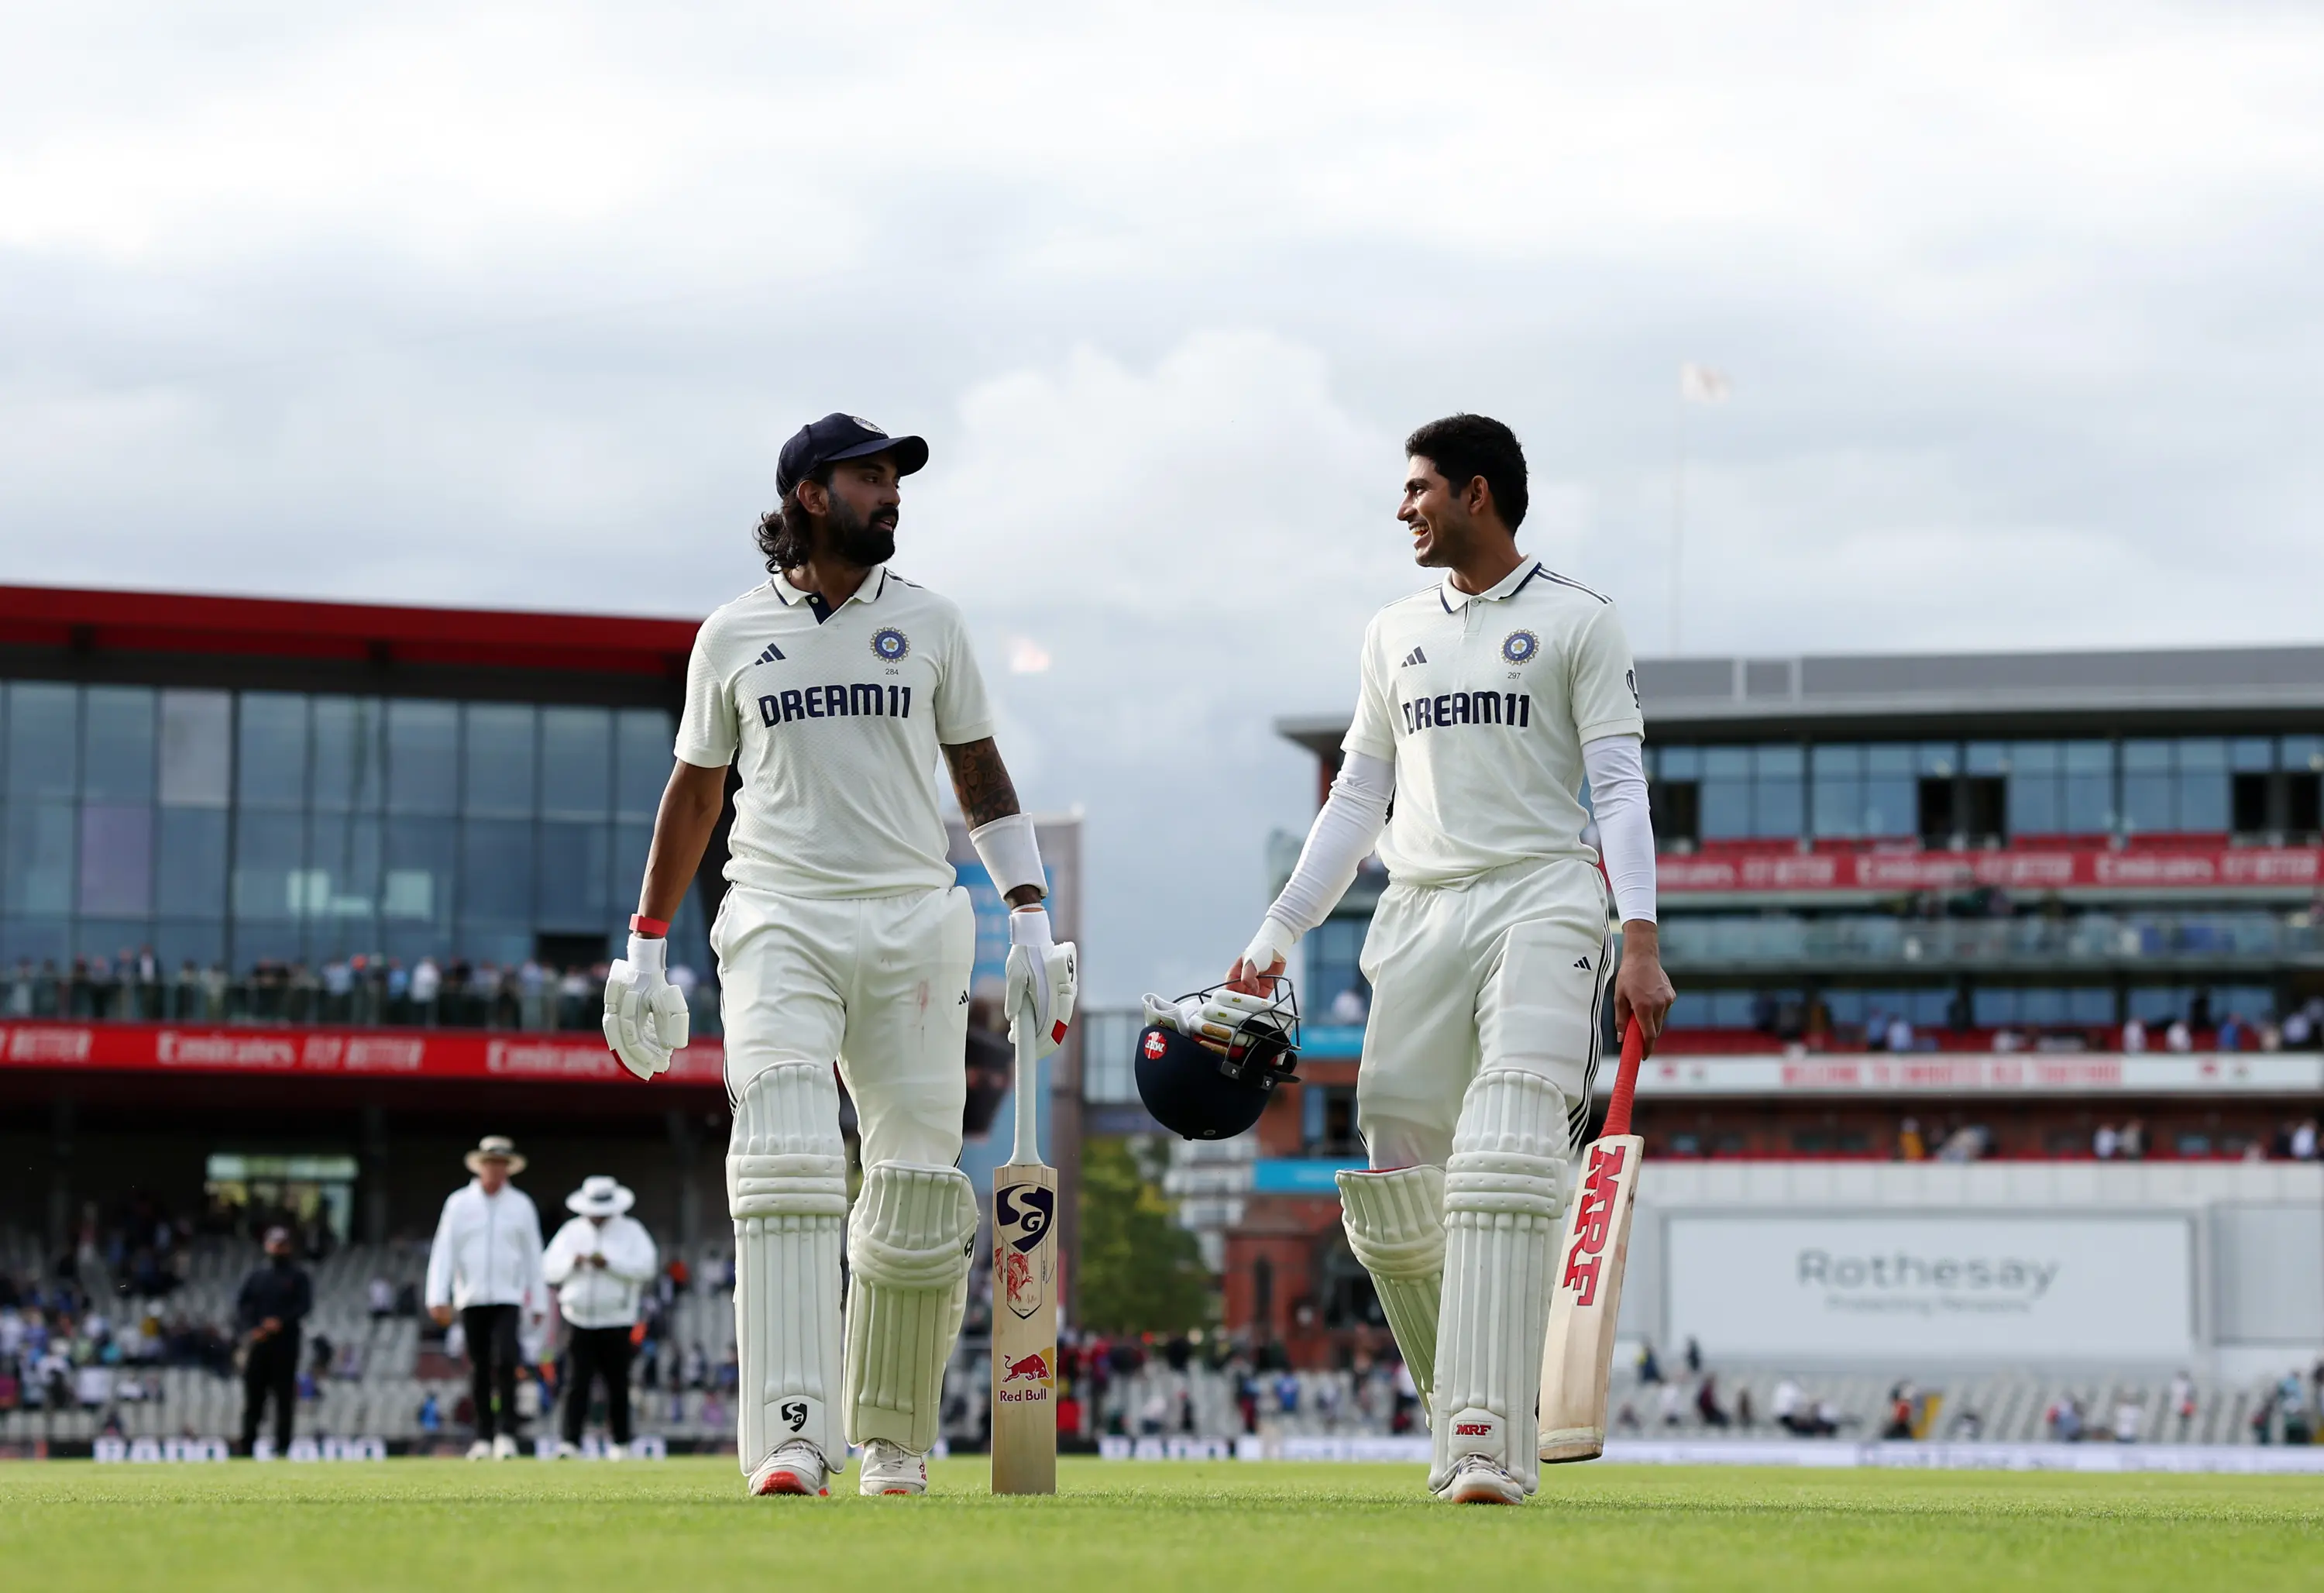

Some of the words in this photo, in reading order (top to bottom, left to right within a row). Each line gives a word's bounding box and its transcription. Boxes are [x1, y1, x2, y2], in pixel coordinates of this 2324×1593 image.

[757, 683, 911, 728] DREAM11
[1402, 691, 1530, 735] DREAM11
[157, 1030, 296, 1067] Emirates
[996, 1184, 1054, 1253] SG
[1563, 1145, 1626, 1306] MRF
[1796, 1248, 2061, 1301] Rothesay
[1000, 1389, 1022, 1402] Red
[1026, 1388, 1047, 1401] Bull
[1456, 1424, 1491, 1436] MRF
